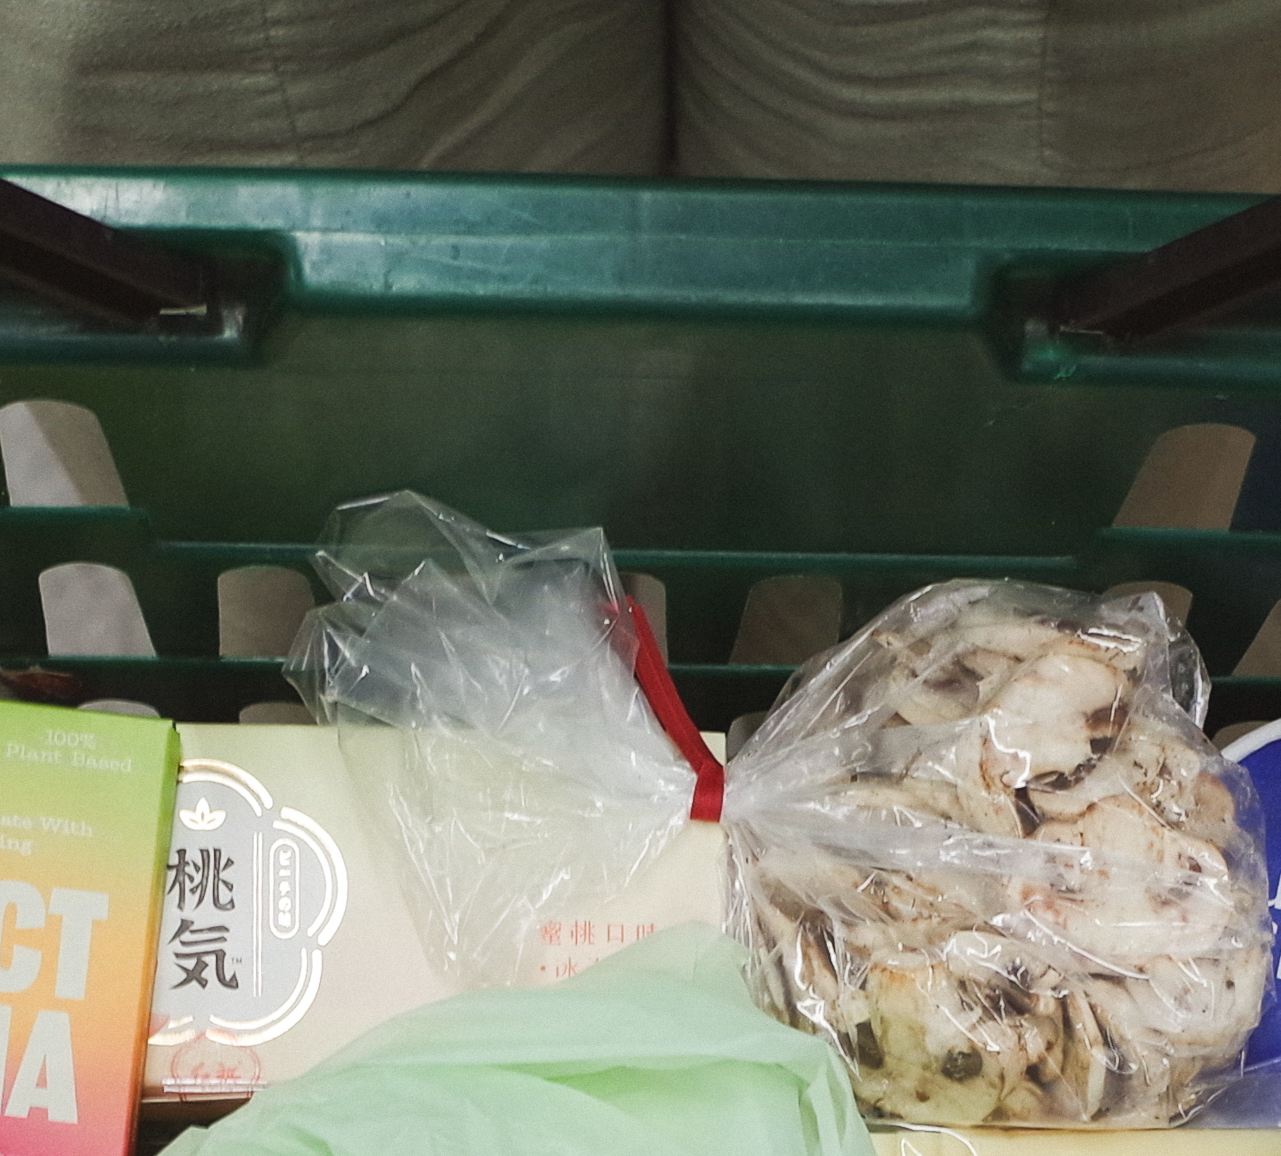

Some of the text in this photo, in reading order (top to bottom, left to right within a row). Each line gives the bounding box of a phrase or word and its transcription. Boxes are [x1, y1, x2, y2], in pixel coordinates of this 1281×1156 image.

[46, 729, 98, 750] 100%
[6, 743, 133, 773] Plant Based
[40, 816, 93, 838] With
[166, 848, 239, 990] 桃気
